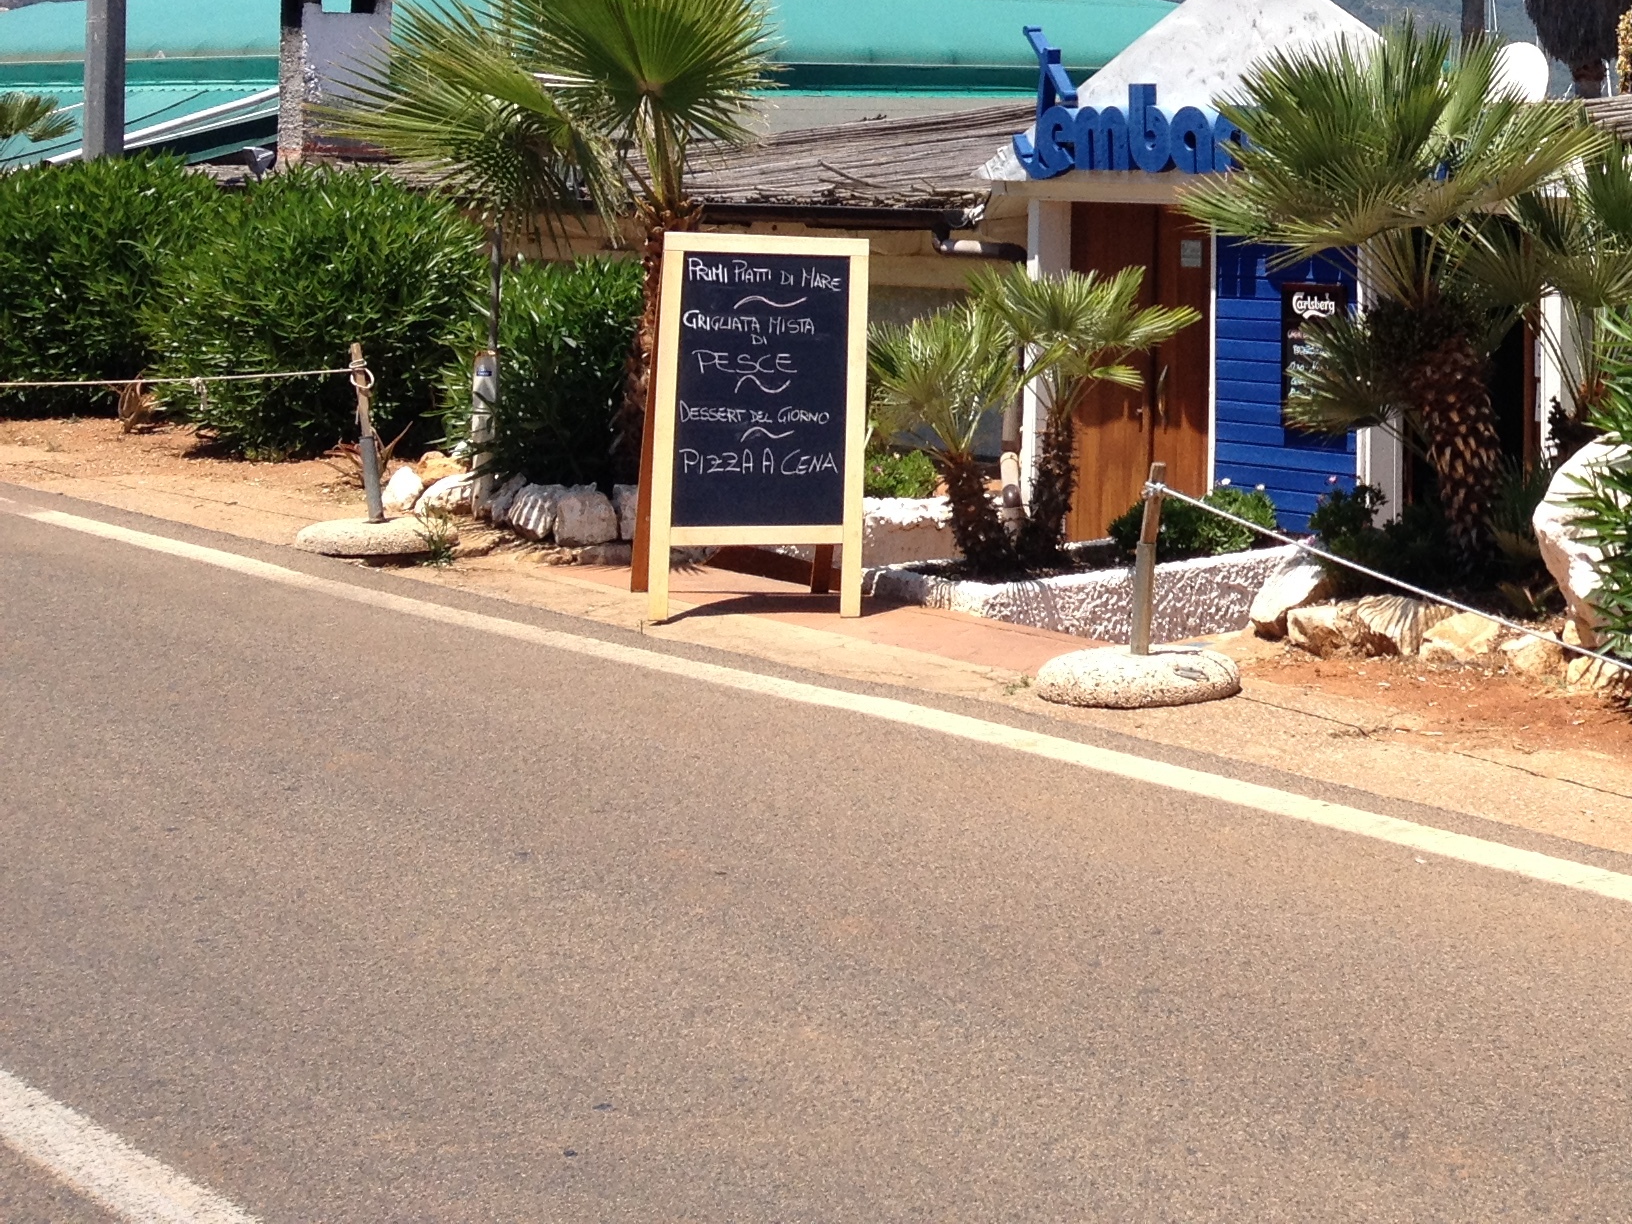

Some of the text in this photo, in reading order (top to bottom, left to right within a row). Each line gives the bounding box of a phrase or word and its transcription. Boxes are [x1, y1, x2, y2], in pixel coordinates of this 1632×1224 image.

[687, 257, 842, 292] PRIMI PIATTI DI MARE
[1292, 291, 1336, 316] Carlsberg
[683, 309, 815, 336] GRIGLIATA MISTA
[751, 333, 768, 345] DI
[691, 349, 798, 374] PESCE
[679, 399, 830, 425] DESSERT DEL GIORNO
[679, 447, 839, 475] PIZZA A CENA
